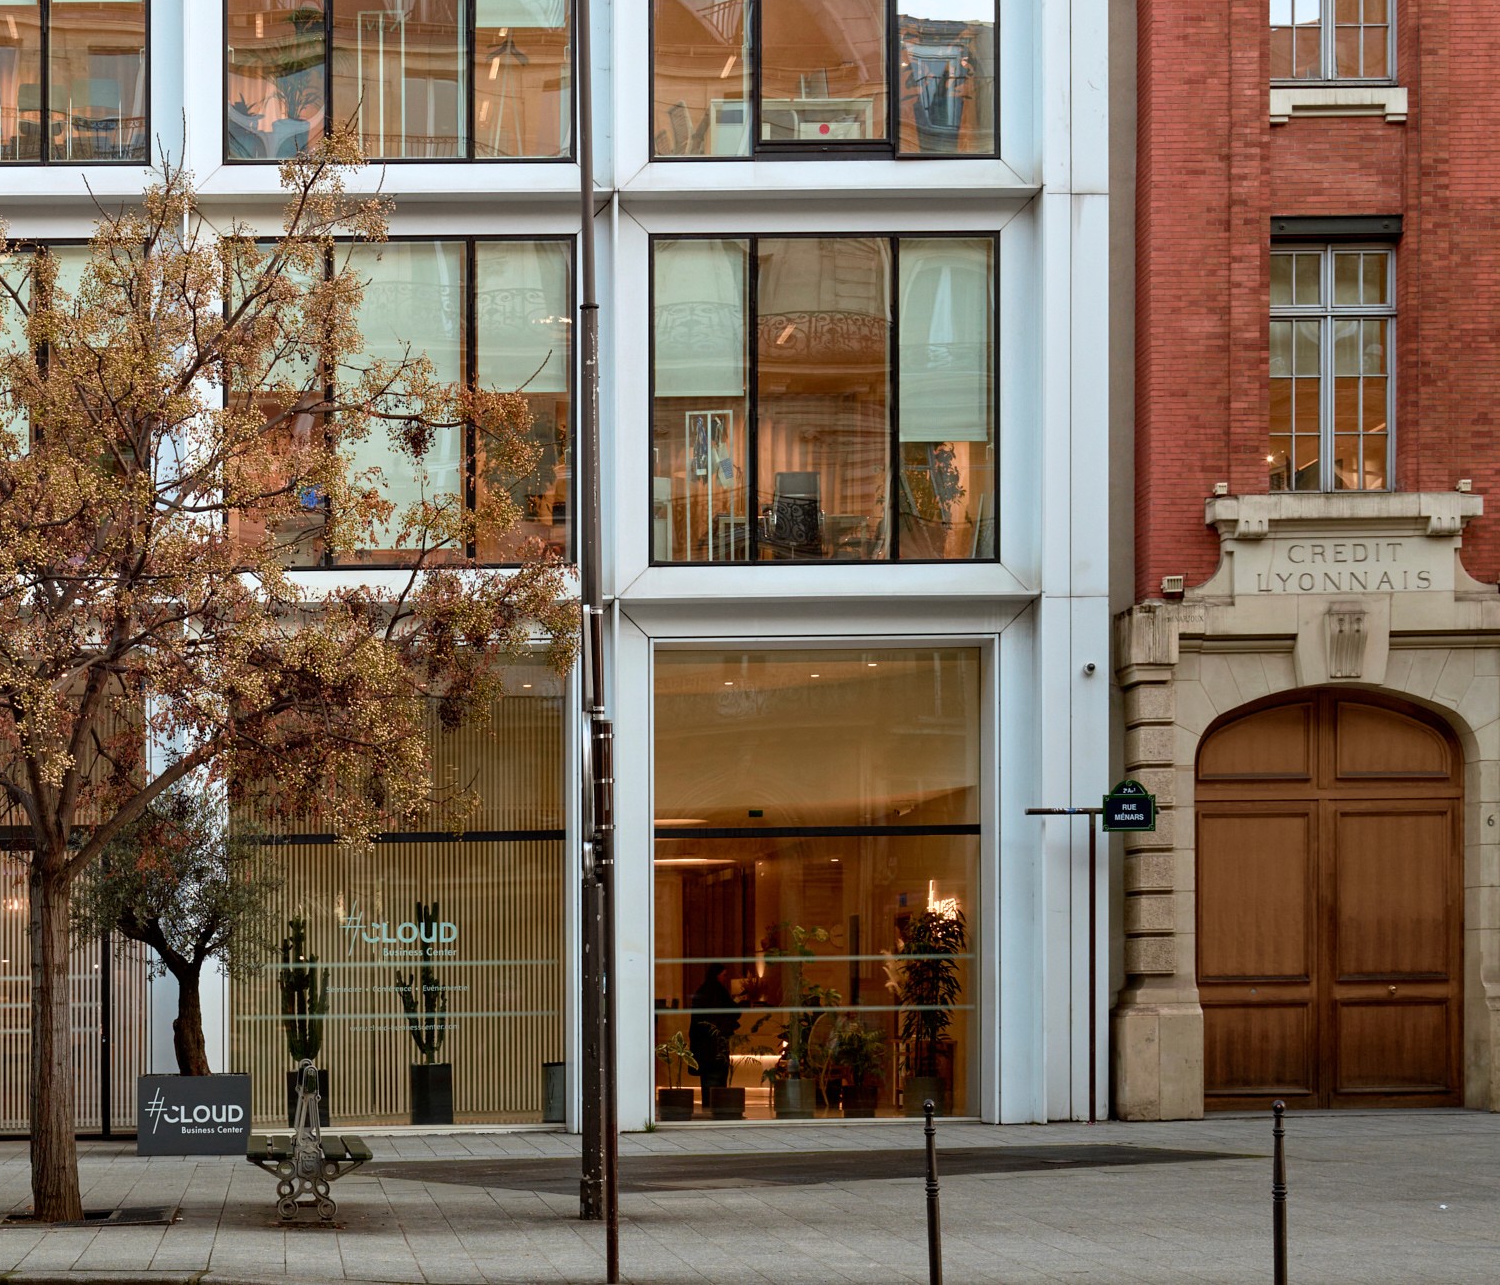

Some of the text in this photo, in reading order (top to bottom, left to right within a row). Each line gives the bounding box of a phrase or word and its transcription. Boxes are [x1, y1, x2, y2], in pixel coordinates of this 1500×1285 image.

[1287, 543, 1403, 564] CREDIT
[1257, 570, 1432, 593] LYONNAIS
[1122, 803, 1137, 811] RUE
[1114, 812, 1145, 821] MÉNARS
[1487, 813, 1495, 827] 6
[383, 947, 457, 956] Business Center
[181, 1125, 244, 1134] Business Center
